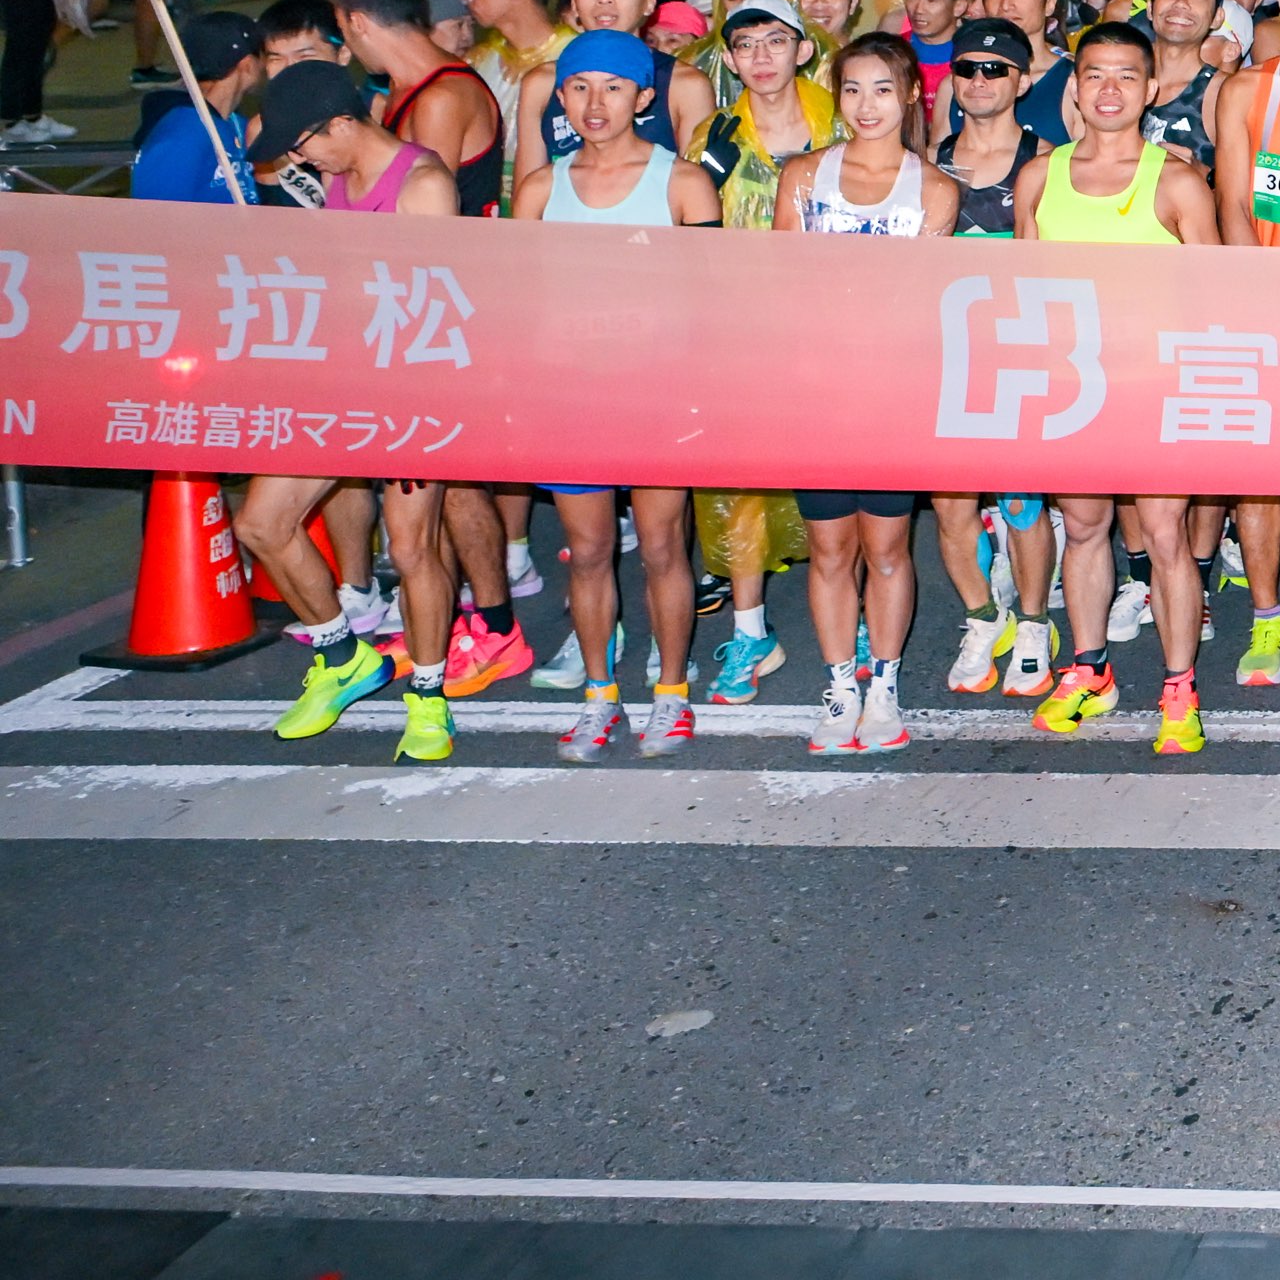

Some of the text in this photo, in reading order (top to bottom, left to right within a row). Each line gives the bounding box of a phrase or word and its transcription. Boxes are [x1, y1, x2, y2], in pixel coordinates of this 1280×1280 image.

[0, 249, 476, 370] 馬拉松
[105, 398, 464, 453] 高雄富邦マラソン
